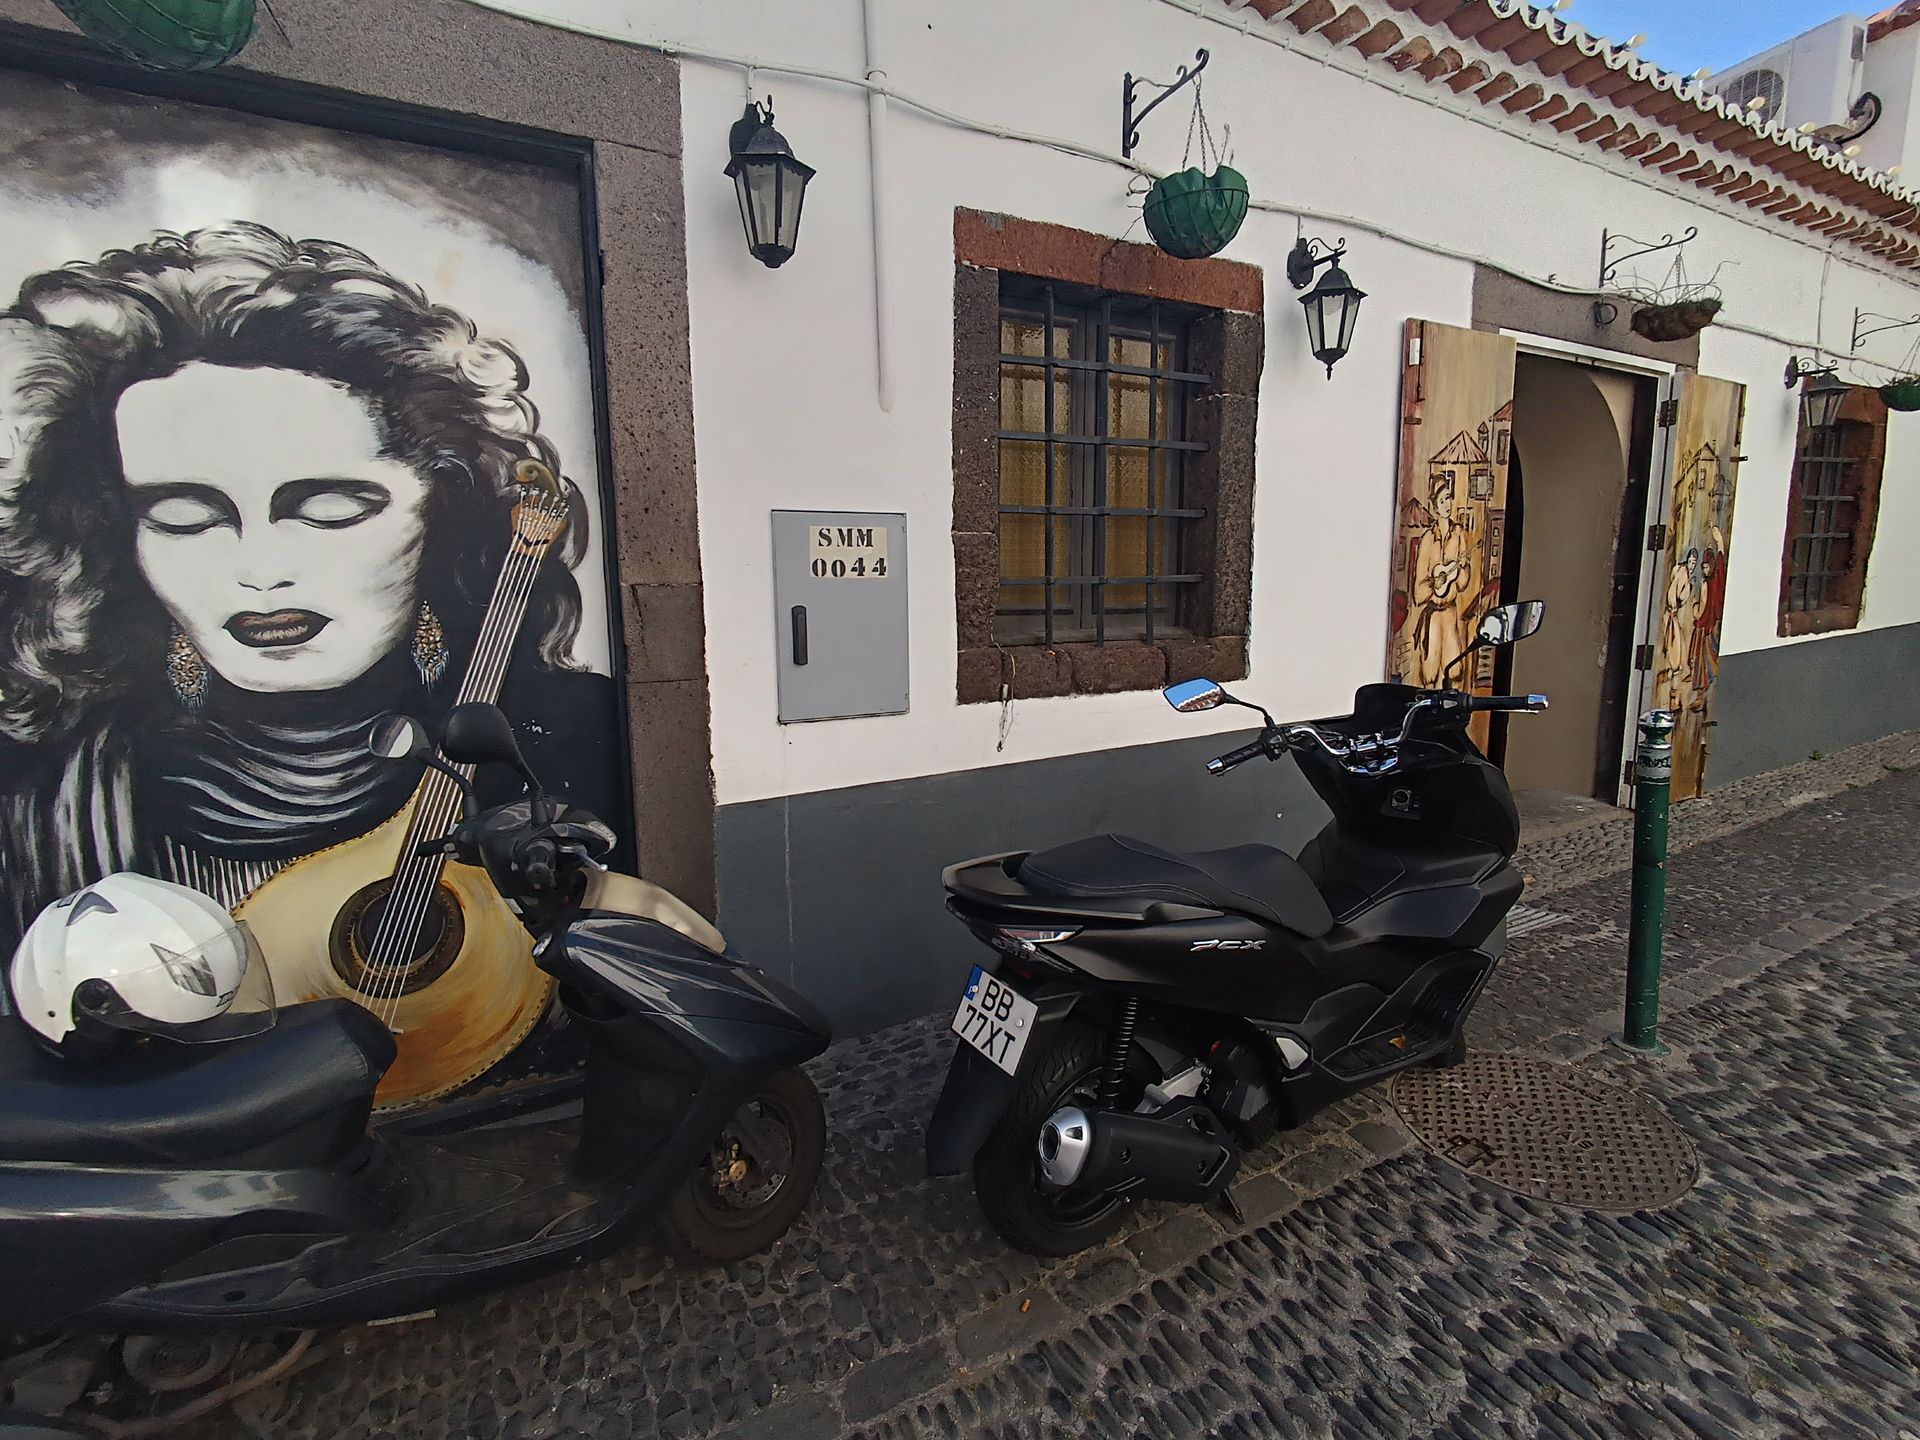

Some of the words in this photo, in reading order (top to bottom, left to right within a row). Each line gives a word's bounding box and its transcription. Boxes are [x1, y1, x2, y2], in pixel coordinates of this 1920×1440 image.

[818, 528, 873, 548] SMM
[812, 557, 887, 578] 0044
[1190, 939, 1266, 952] PCX
[981, 979, 1014, 1022] BB
[961, 1004, 1016, 1064] 77XT
